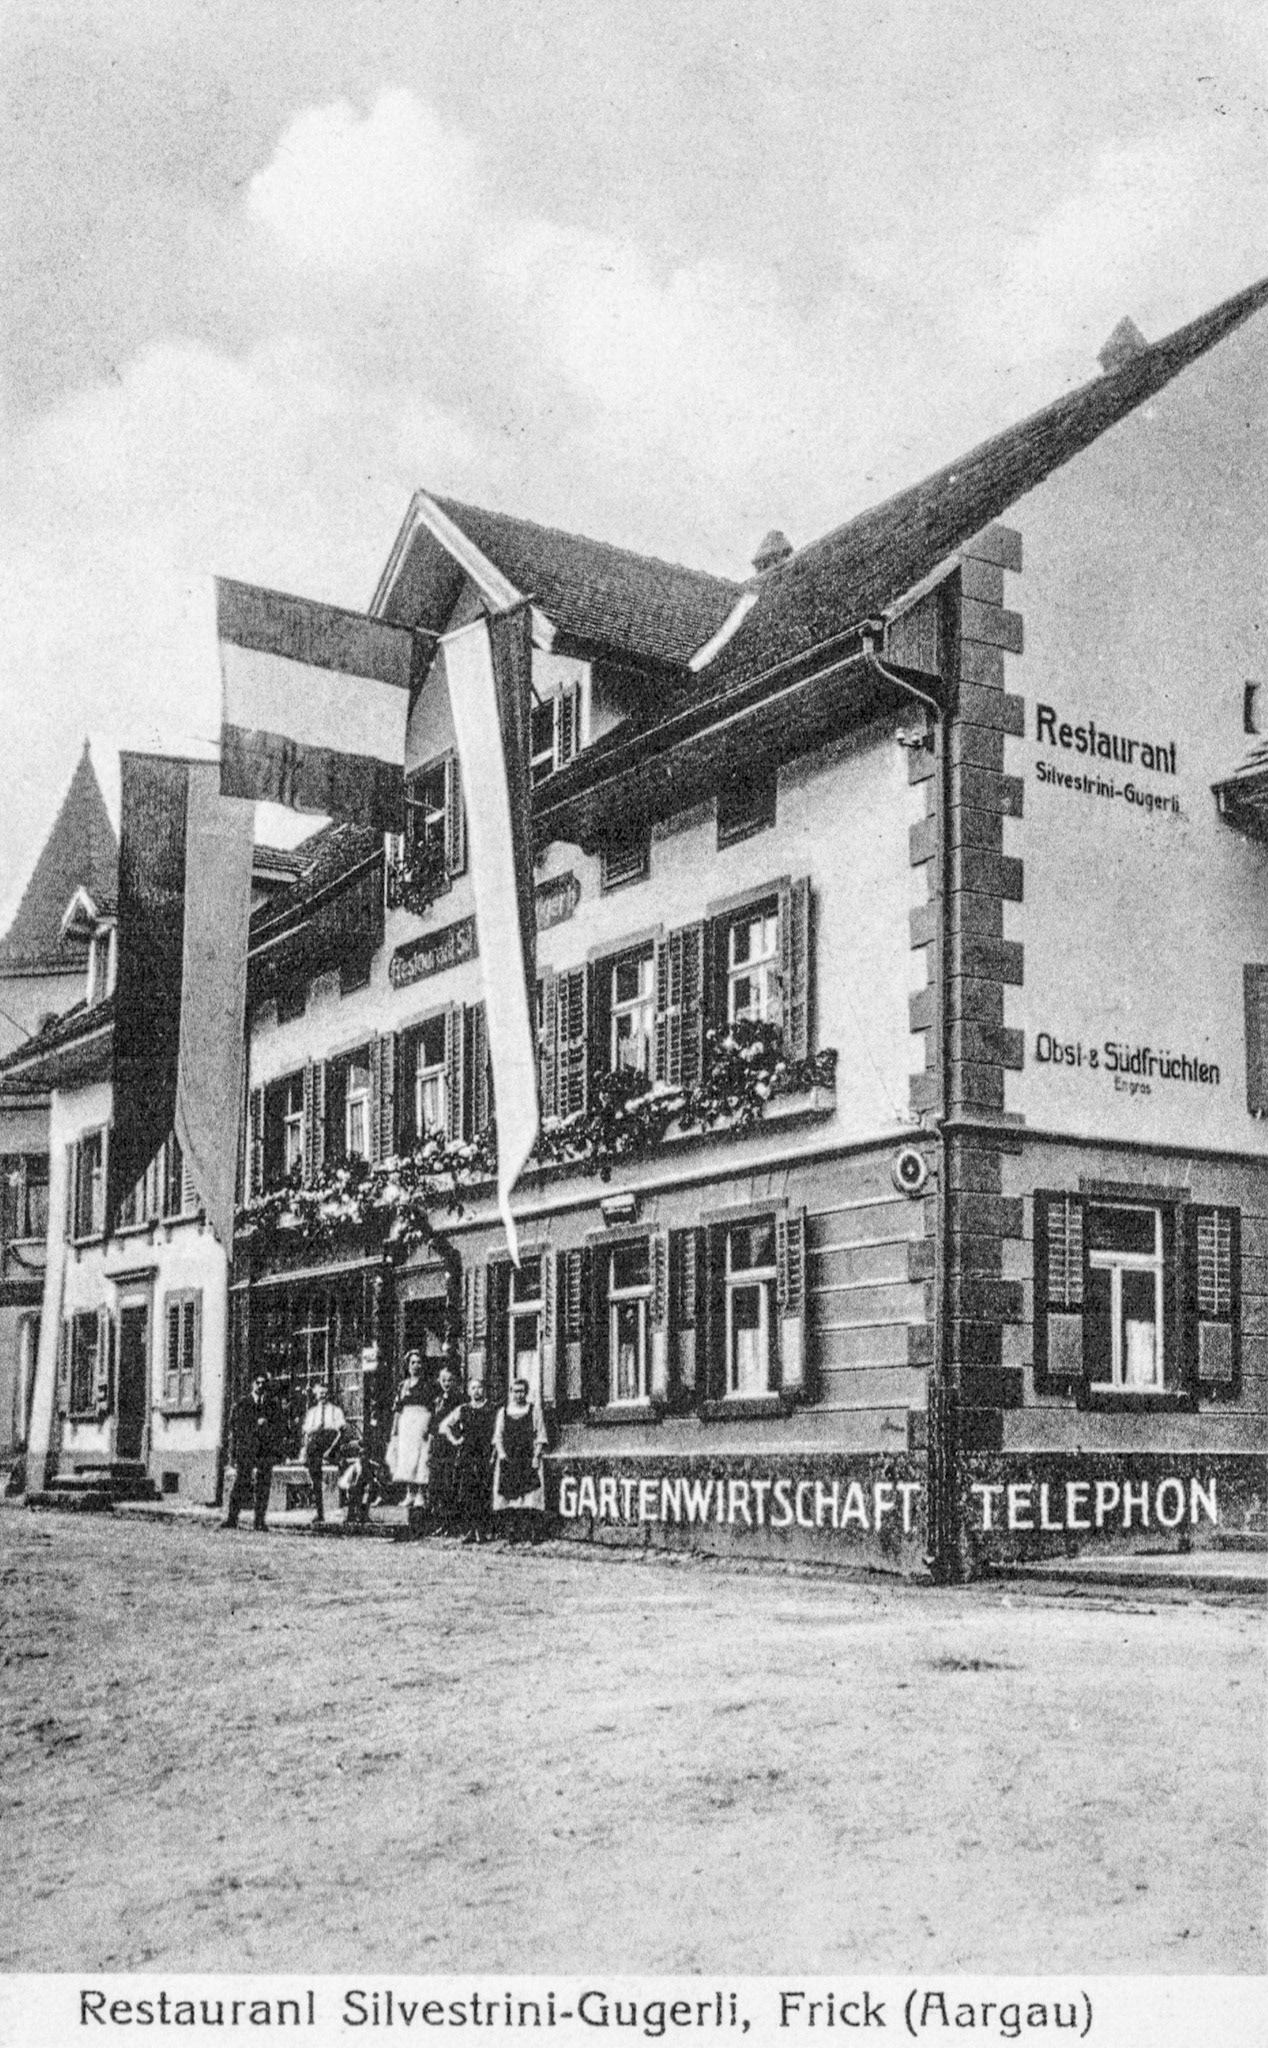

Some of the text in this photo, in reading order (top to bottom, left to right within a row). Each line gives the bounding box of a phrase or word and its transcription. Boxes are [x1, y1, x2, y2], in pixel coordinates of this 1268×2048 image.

[1035, 702, 1177, 775] Restaurant
[1088, 1048, 1101, 1070] &
[558, 1474, 922, 1534] GARTENWIRTSCHAFT
[970, 1477, 1218, 1532] TELEPHON
